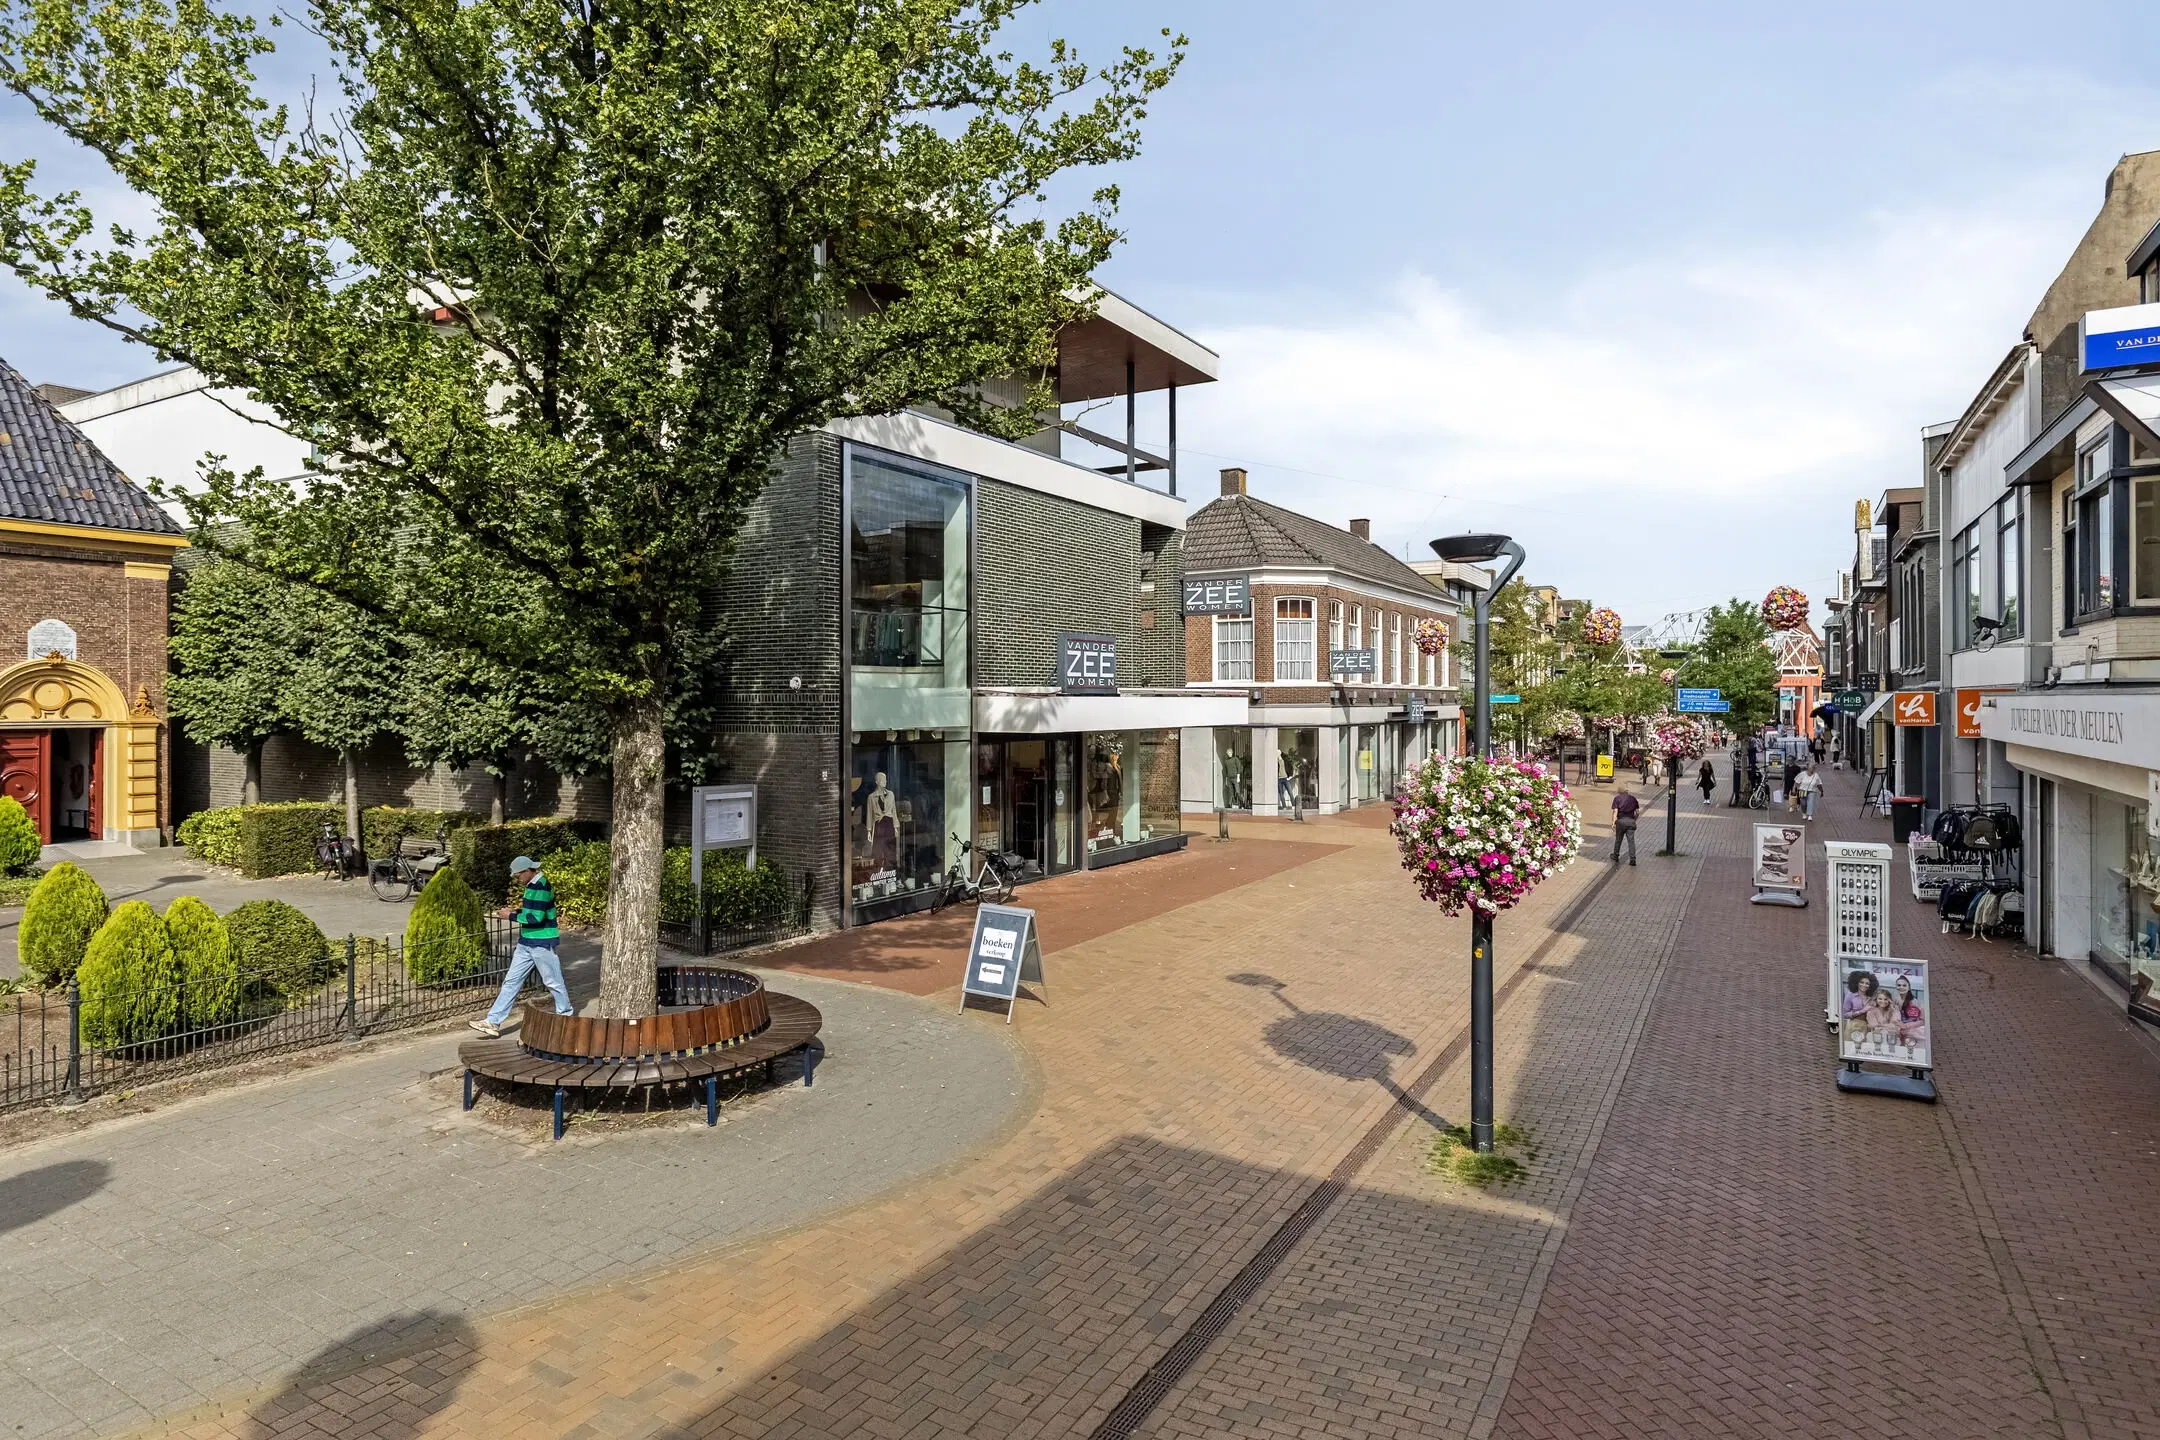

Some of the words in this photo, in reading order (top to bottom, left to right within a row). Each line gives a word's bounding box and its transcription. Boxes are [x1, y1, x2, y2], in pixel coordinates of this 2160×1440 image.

[2116, 337, 2143, 347] VAN
[1186, 585, 1243, 605] ZEE
[1186, 603, 1243, 611] WOMEN
[1067, 641, 1090, 650] VAN
[1092, 643, 1115, 652] DER
[1067, 650, 1115, 678] ZEE
[1333, 656, 1371, 668] ZEE
[1067, 677, 1115, 686] WOMEN
[1412, 704, 1424, 717] ZEE
[1963, 727, 1981, 735] van
[2011, 707, 2042, 734] JUWELIER
[2043, 709, 2058, 735] VAN
[2060, 709, 2078, 739] DER
[2080, 711, 2124, 744] MEULEN
[1841, 848, 1878, 858] OLYMPIC
[982, 935, 1013, 950] boeken
